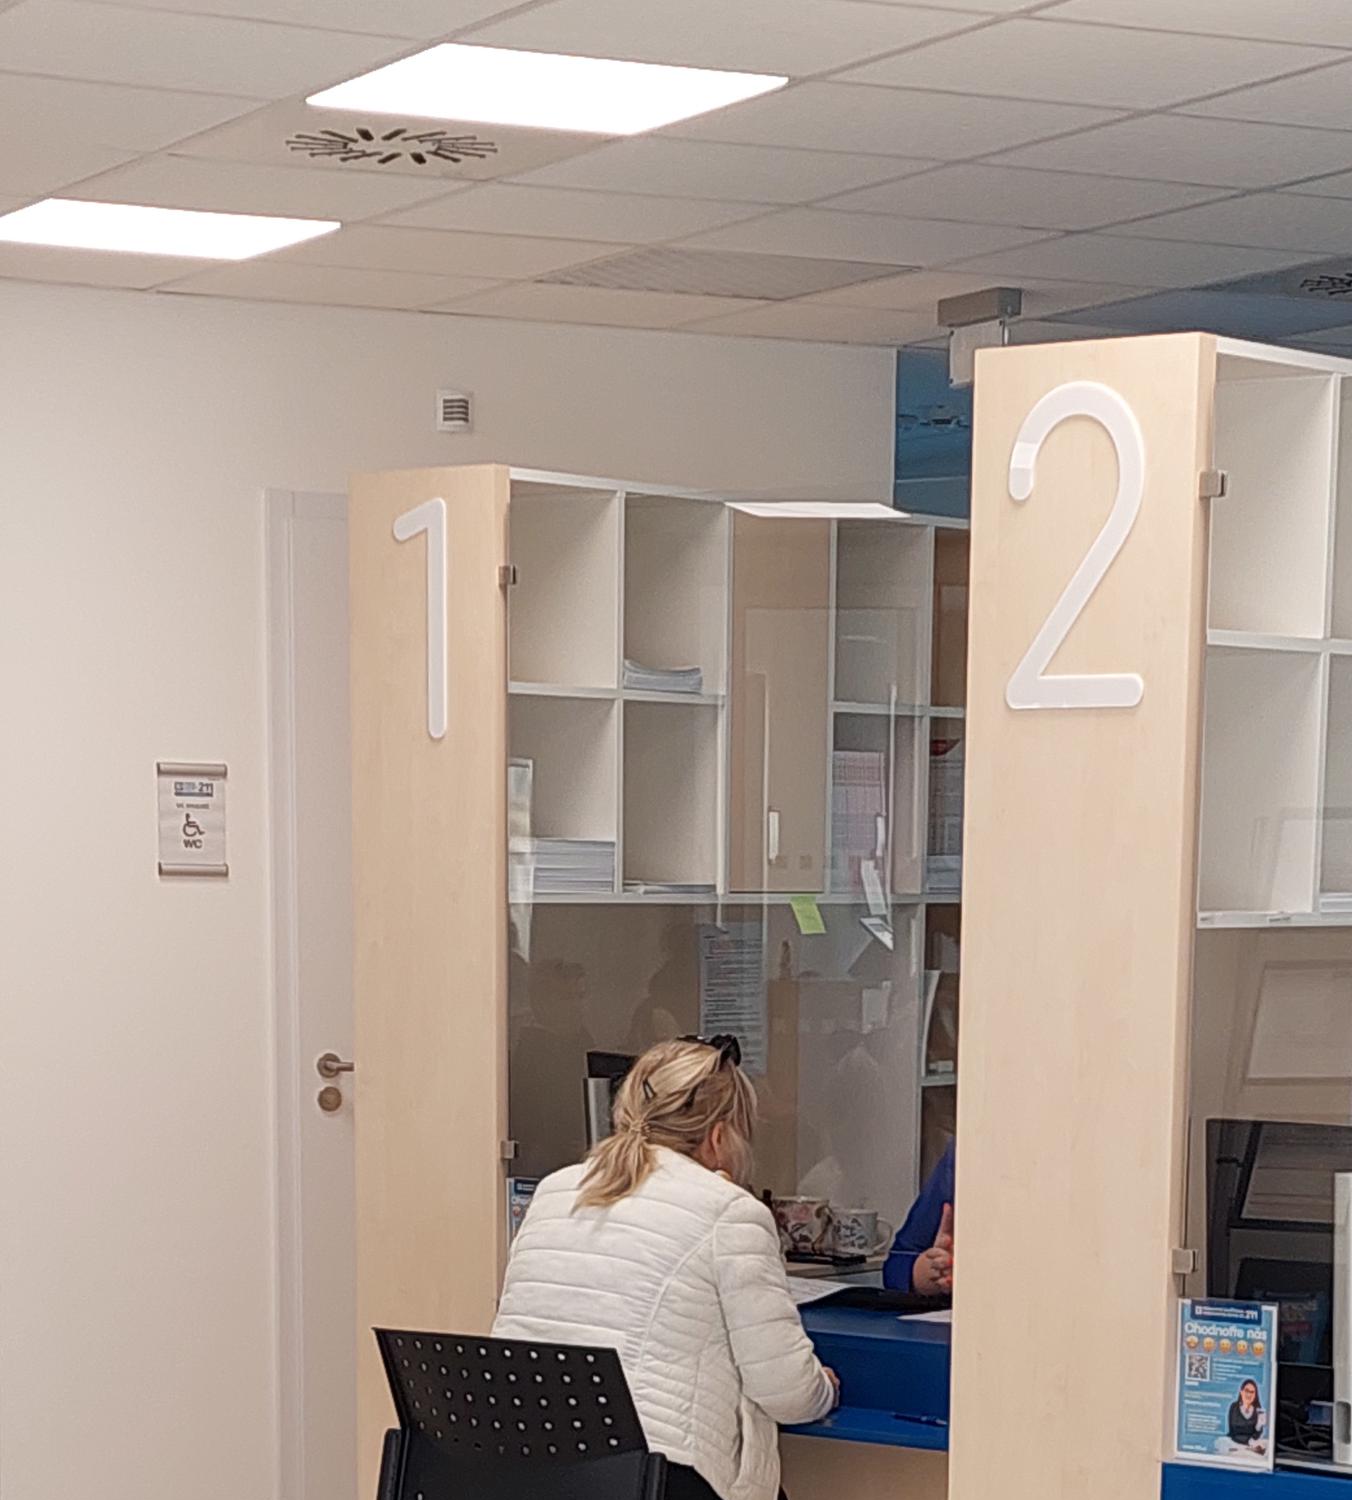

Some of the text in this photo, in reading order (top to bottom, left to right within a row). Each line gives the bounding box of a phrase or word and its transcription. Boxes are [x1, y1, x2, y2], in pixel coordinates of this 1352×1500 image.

[392, 497, 447, 741] 1
[1006, 380, 1145, 710] 2
[183, 839, 203, 849] WC
